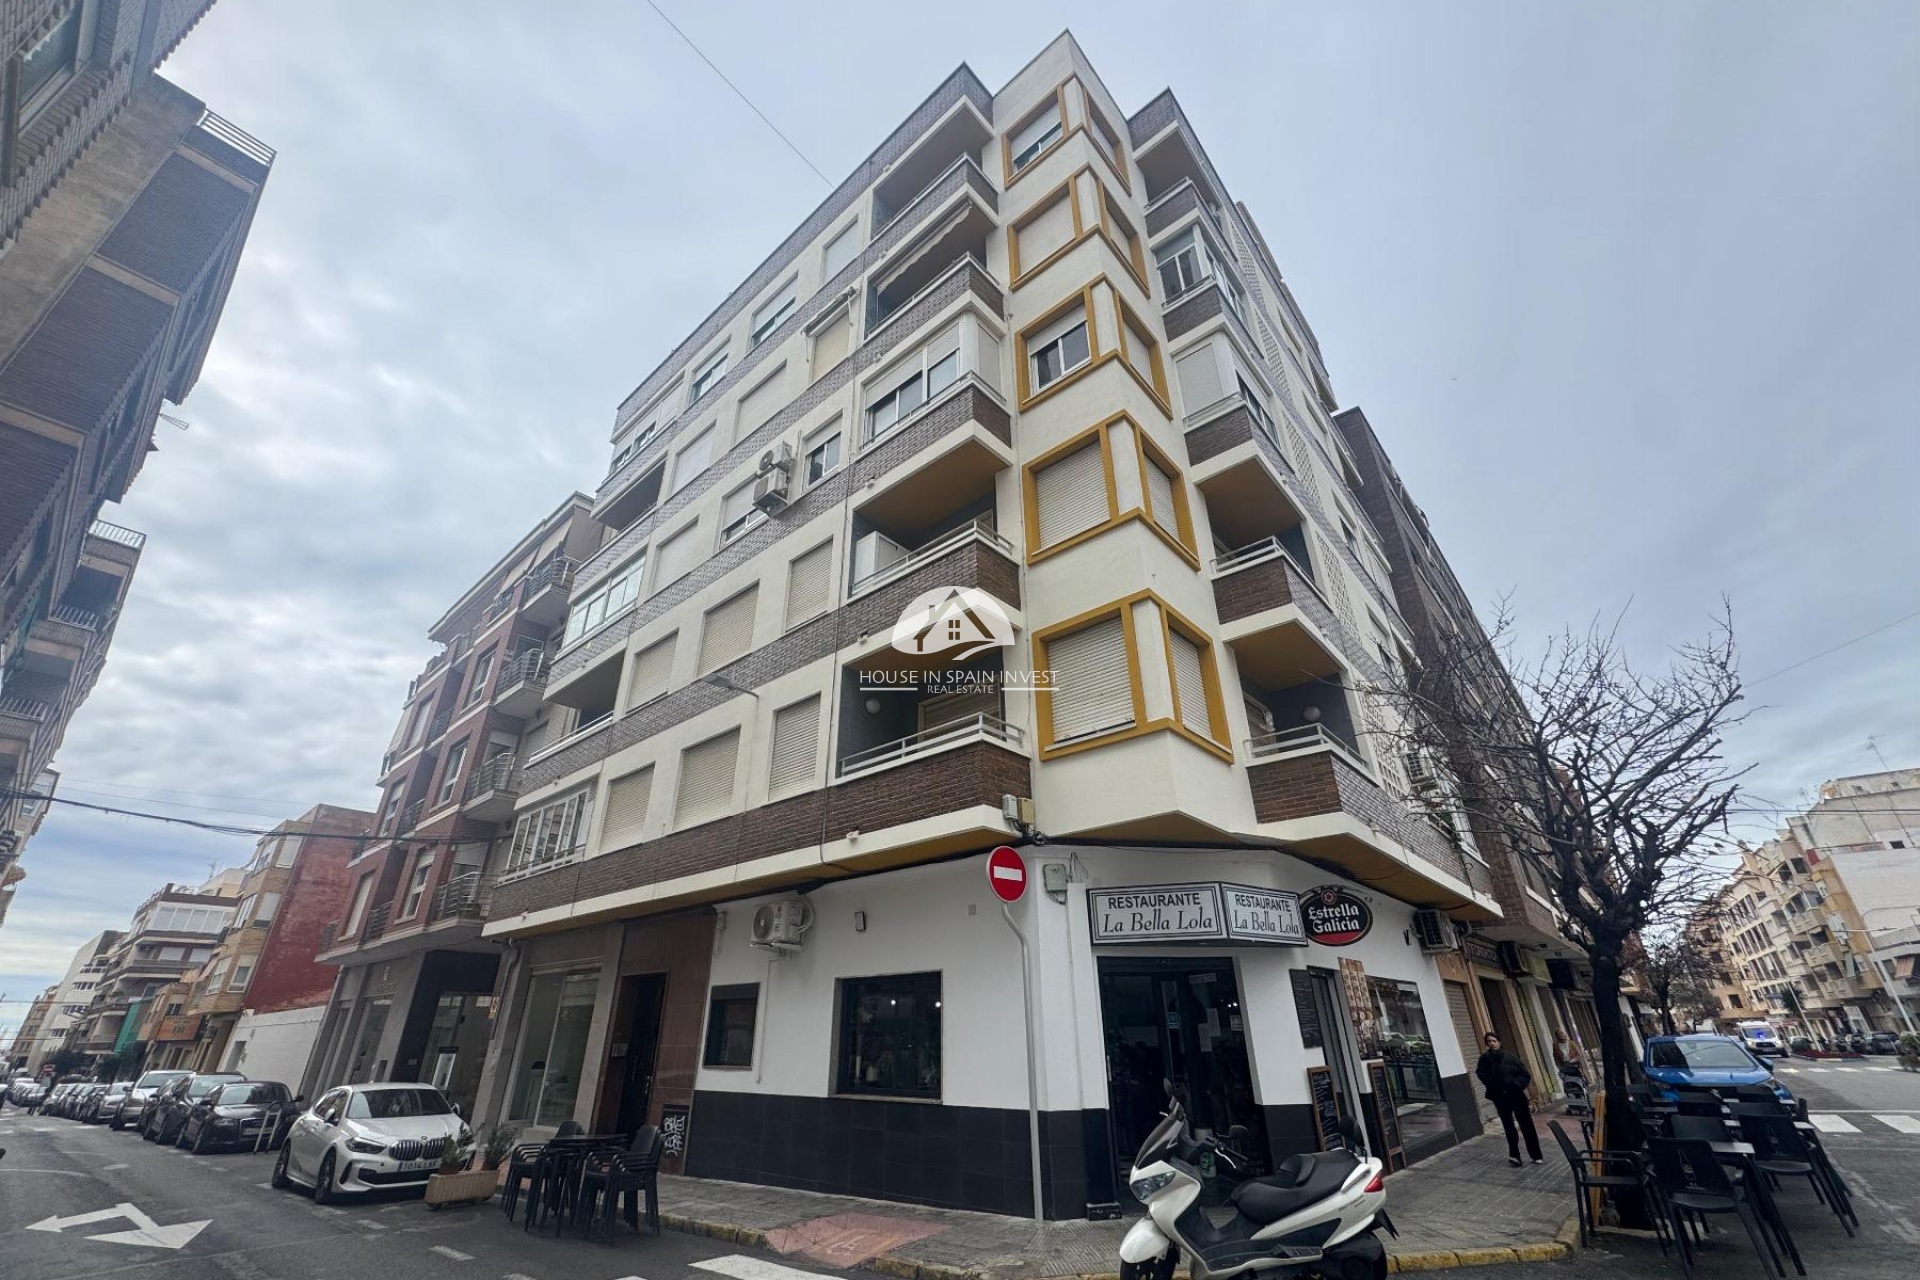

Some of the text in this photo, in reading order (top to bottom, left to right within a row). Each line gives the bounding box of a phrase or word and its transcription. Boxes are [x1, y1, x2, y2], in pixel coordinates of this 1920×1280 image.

[1108, 893, 1201, 910] RESTAURANTE
[1234, 894, 1291, 912] RESTAURANTE
[1103, 906, 1213, 933] La Bella Lola
[1308, 902, 1360, 920] Estrella
[1233, 909, 1299, 935] La Bella Lola
[1312, 917, 1360, 934] Galicia
